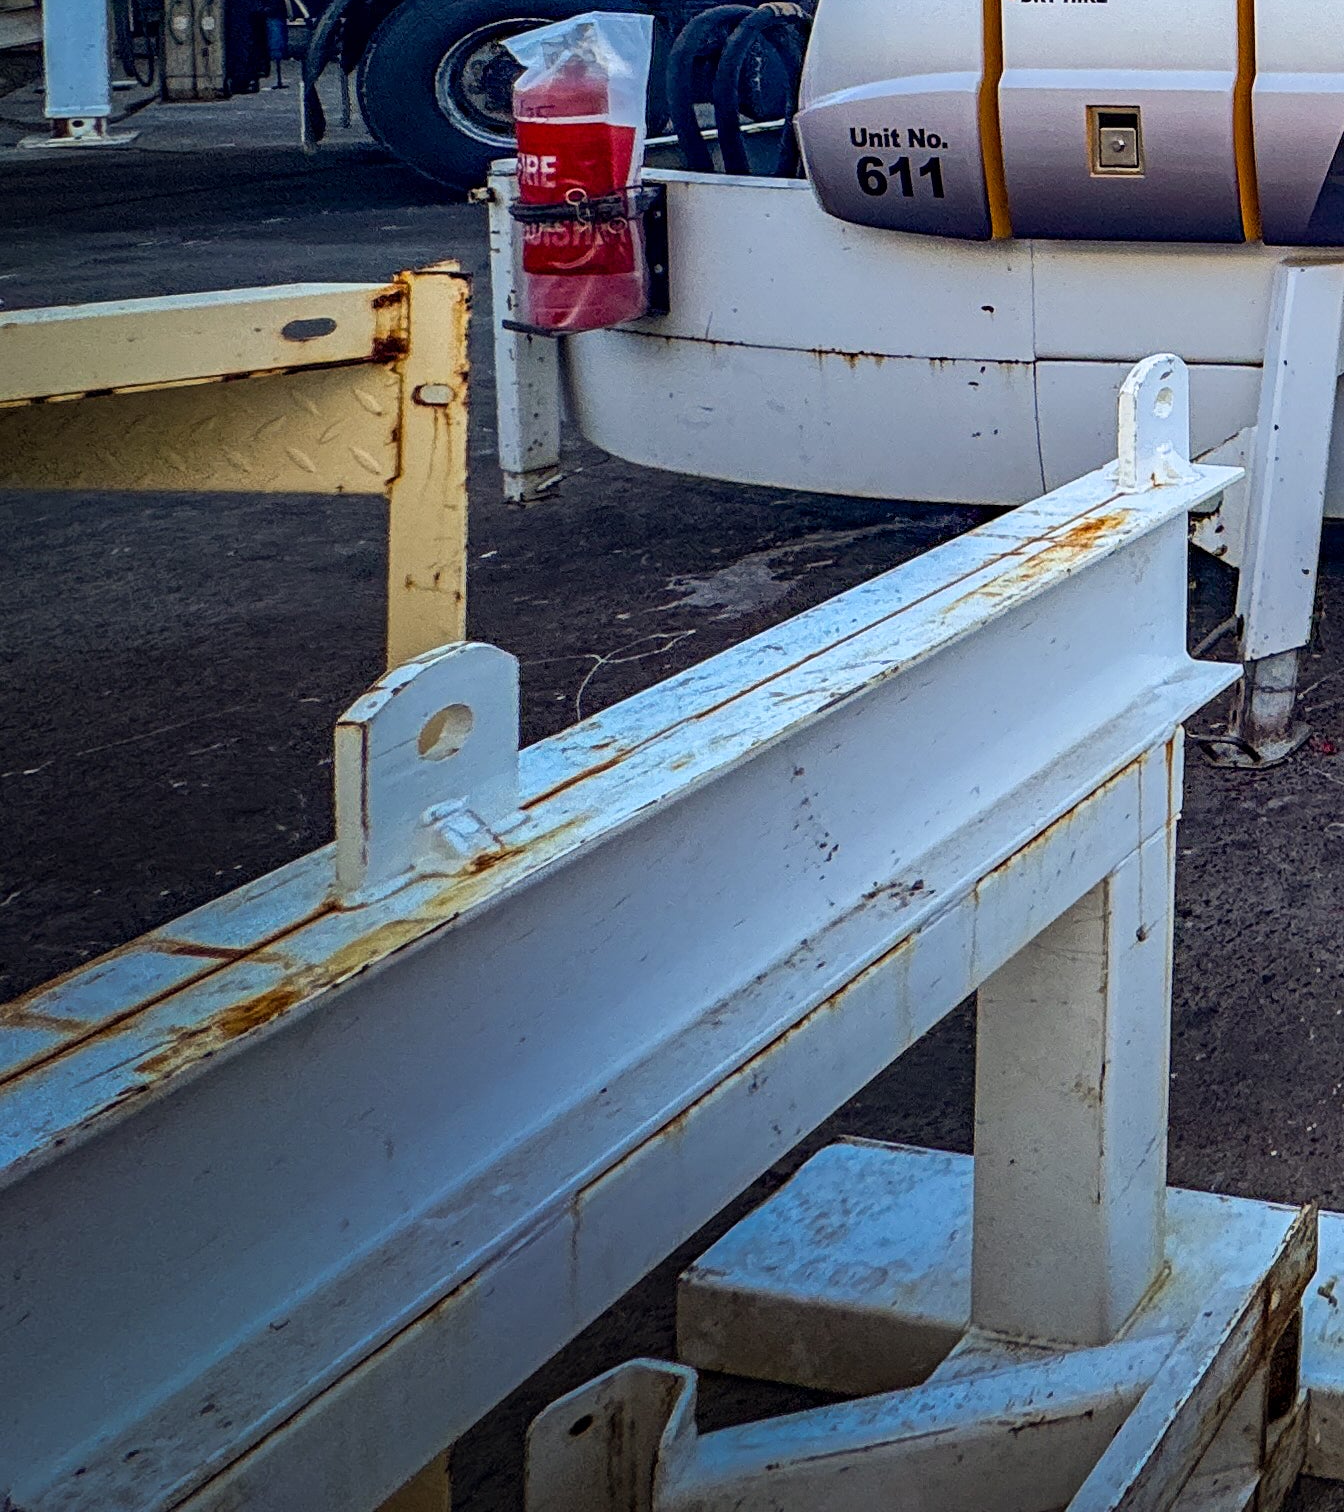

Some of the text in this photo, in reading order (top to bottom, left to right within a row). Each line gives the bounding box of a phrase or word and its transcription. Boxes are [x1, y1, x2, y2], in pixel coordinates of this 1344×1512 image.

[850, 127, 948, 148] Unit No.
[856, 156, 945, 198] 611
